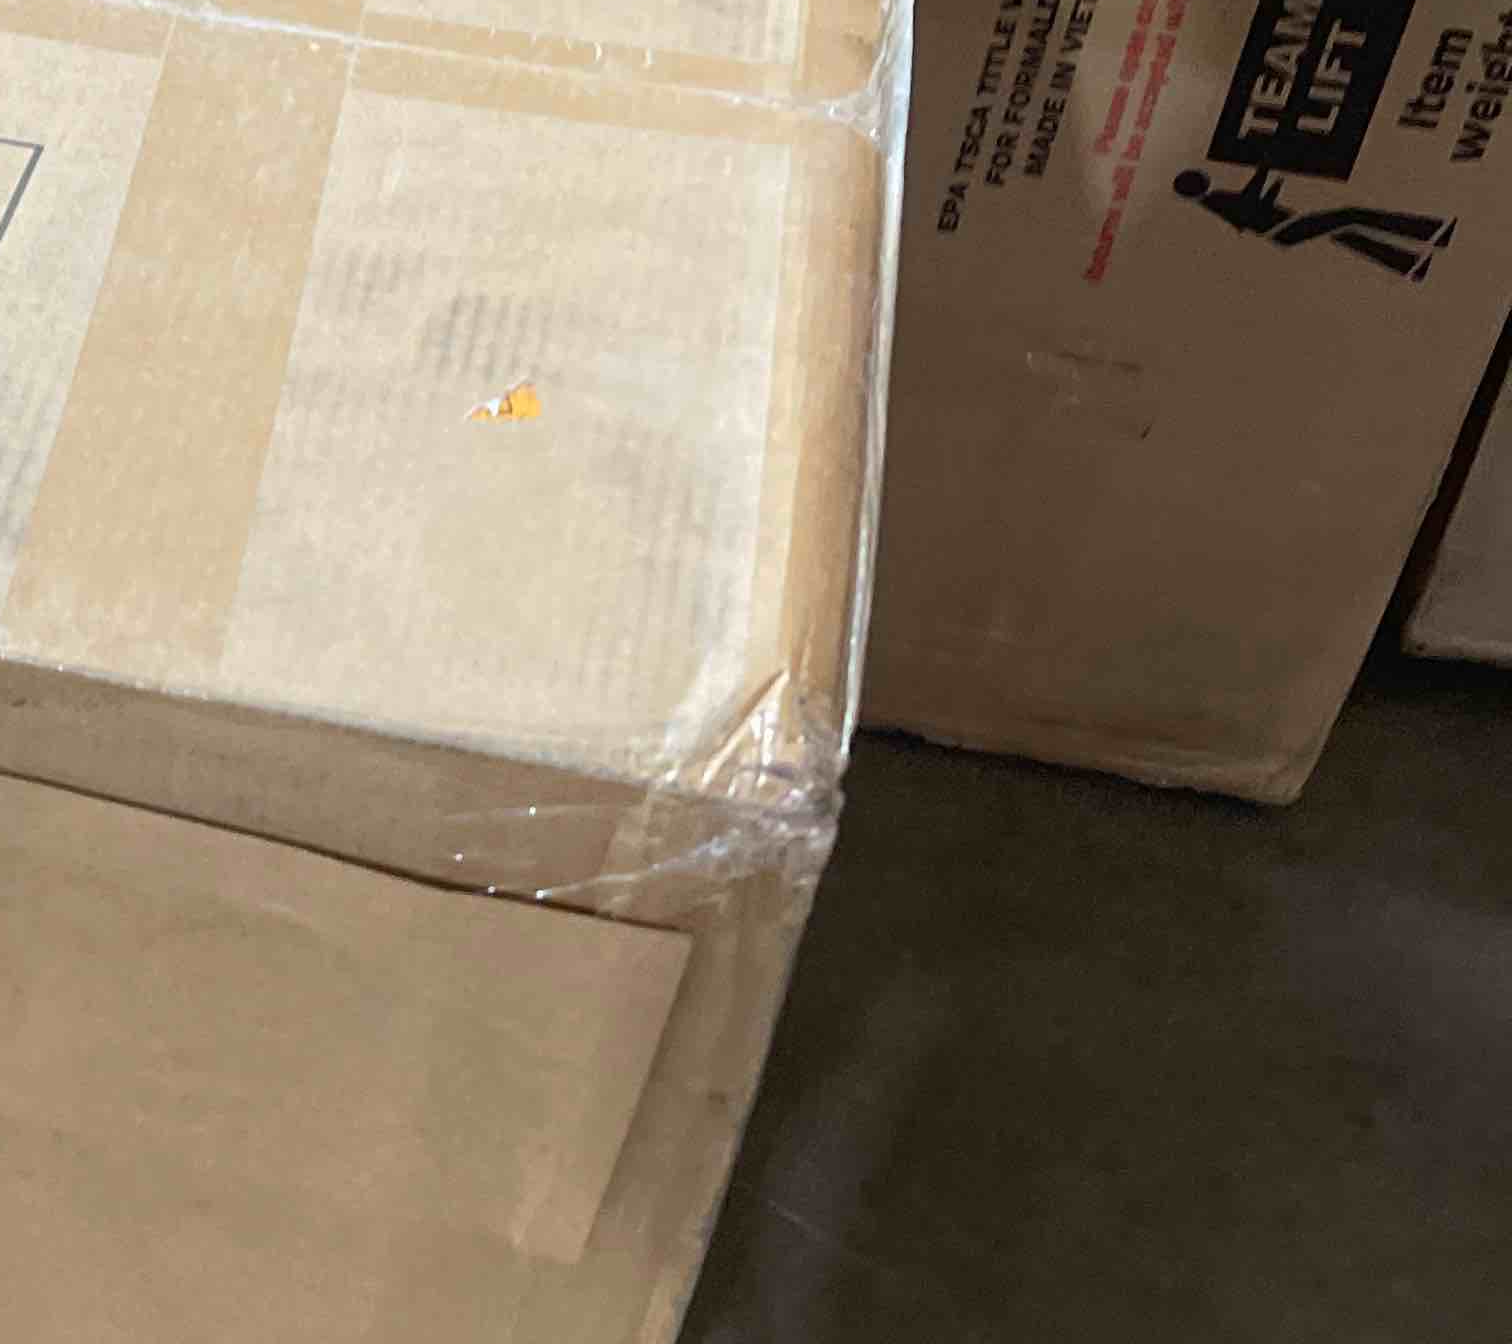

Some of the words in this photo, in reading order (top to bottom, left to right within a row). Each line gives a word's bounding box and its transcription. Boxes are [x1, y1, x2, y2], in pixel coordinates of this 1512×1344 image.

[937, 182, 970, 234] EPA
[954, 105, 992, 173] TSCA
[976, 17, 1017, 97] TITLE
[1024, 95, 1066, 178] MADE
[1049, 60, 1077, 95] IN
[1296, 18, 1369, 139] LIFT
[1398, 28, 1475, 129] Item
[985, 131, 1021, 188] FOR
